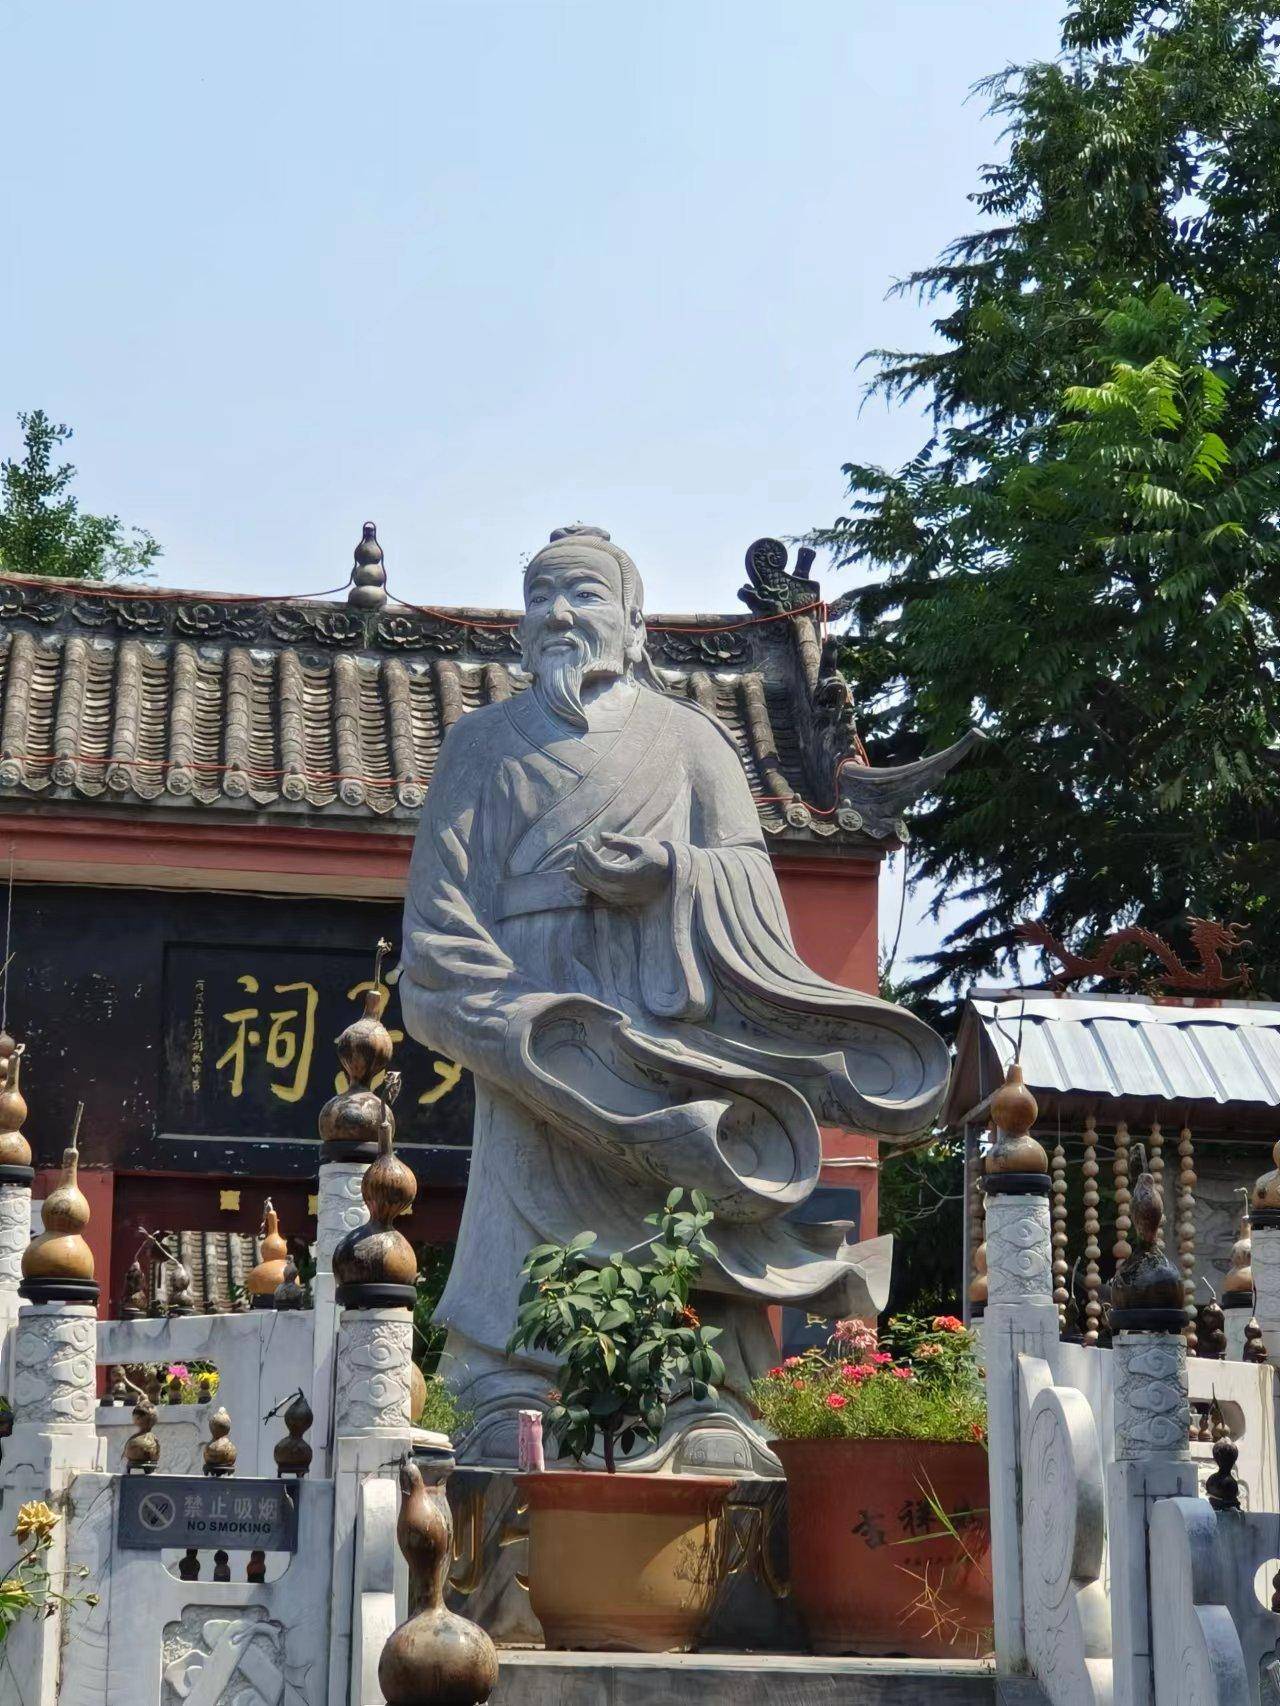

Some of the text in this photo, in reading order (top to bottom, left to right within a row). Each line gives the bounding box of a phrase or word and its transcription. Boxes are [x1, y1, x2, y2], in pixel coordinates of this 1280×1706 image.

[183, 1494, 278, 1520] 禁止吸烟
[187, 1520, 272, 1533] NO SMOKING
